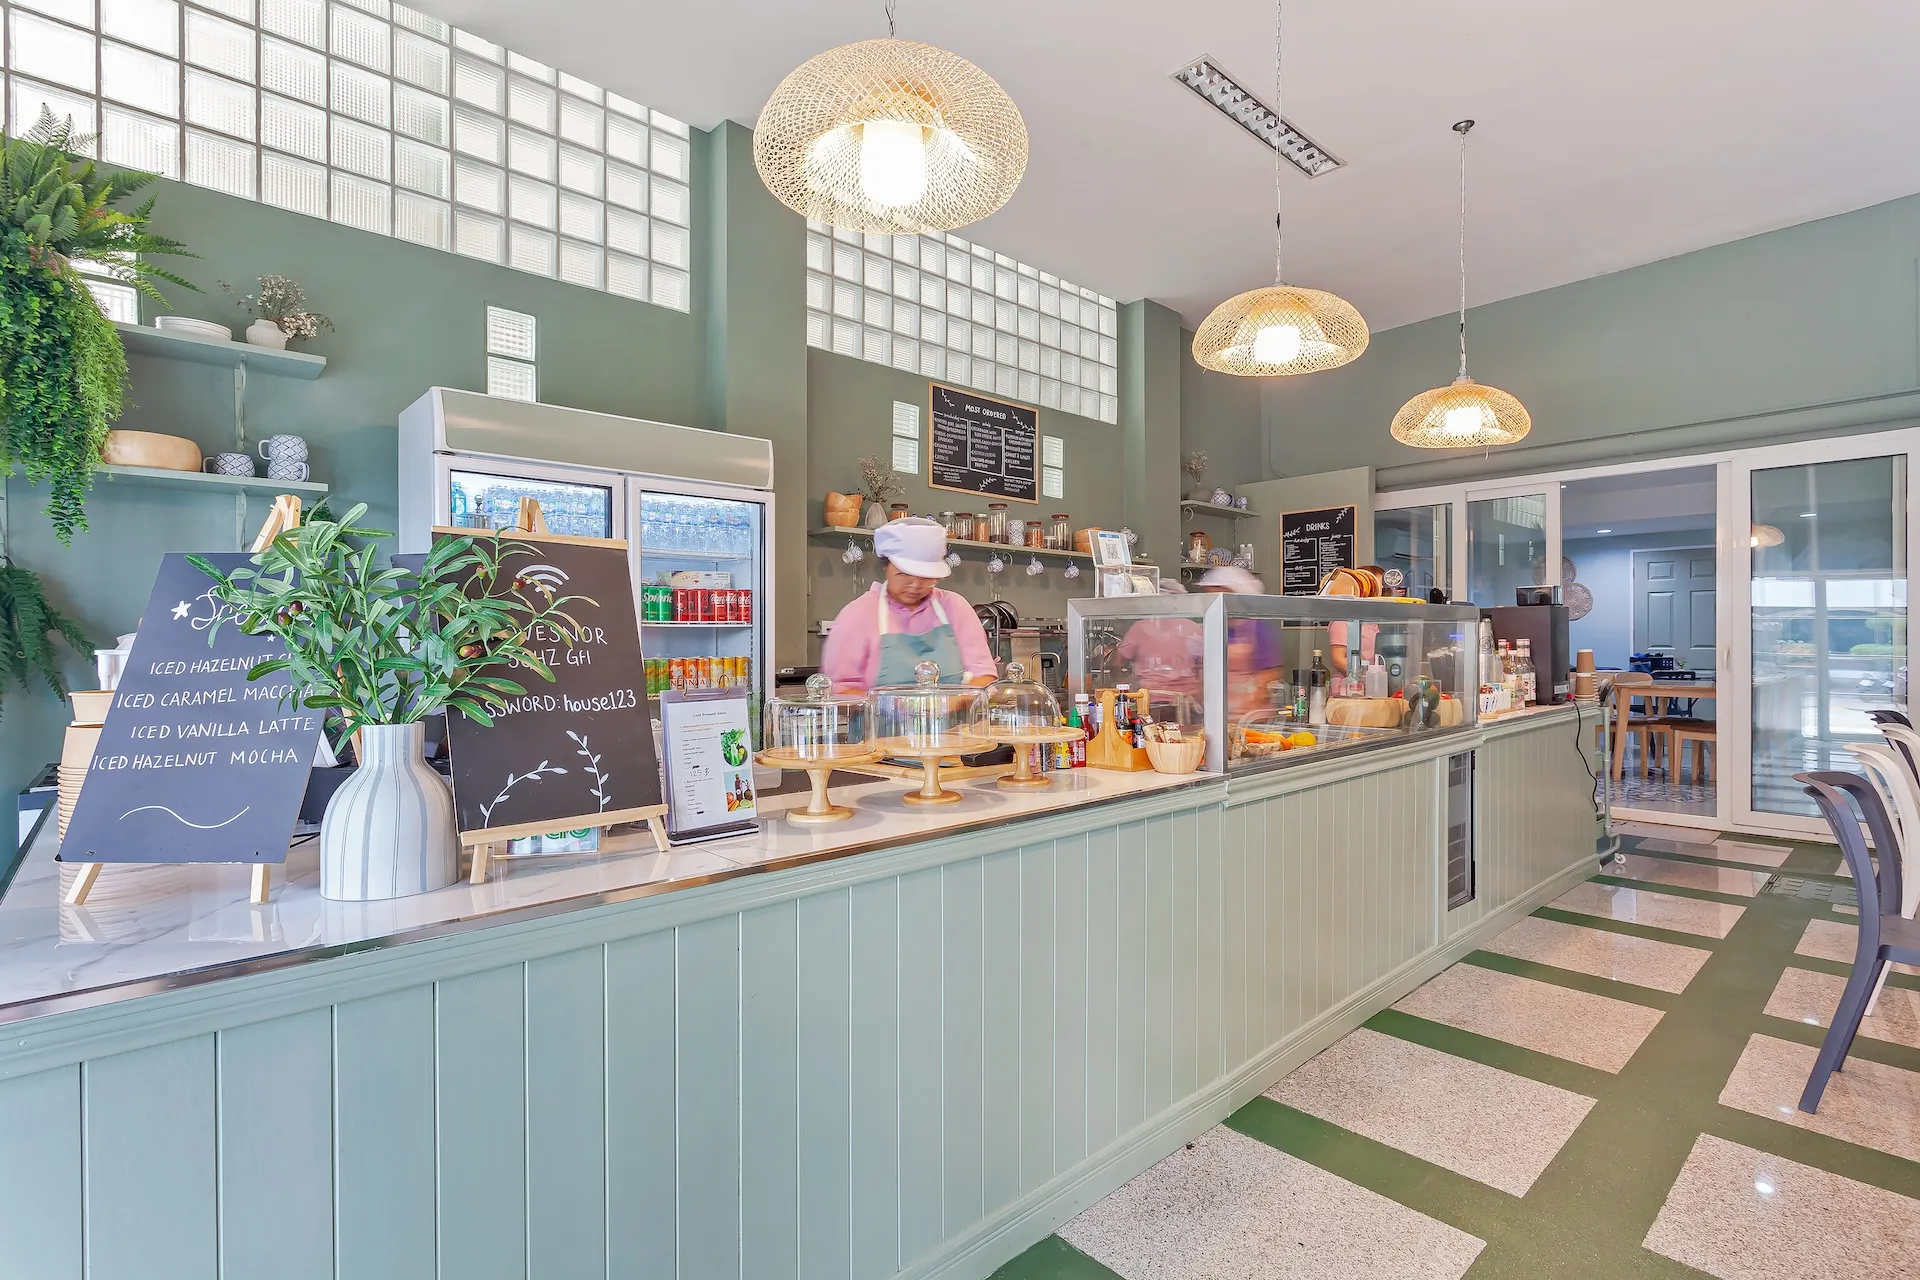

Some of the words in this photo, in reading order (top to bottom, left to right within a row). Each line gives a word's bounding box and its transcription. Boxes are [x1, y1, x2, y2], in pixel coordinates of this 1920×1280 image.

[965, 403, 981, 414] MOST
[982, 408, 1007, 420] ORDERED
[1305, 522, 1330, 532] DRINKS
[150, 661, 187, 675] ICED
[117, 693, 155, 709] ICED
[160, 687, 237, 707] CARAMEL
[563, 689, 637, 713] house123
[130, 725, 171, 739] ICED
[177, 721, 250, 740] VANILLA
[258, 716, 314, 735] LATTE
[92, 755, 128, 770] ICED
[132, 751, 218, 770] HAZELNUT
[229, 747, 299, 765] MOCHA
